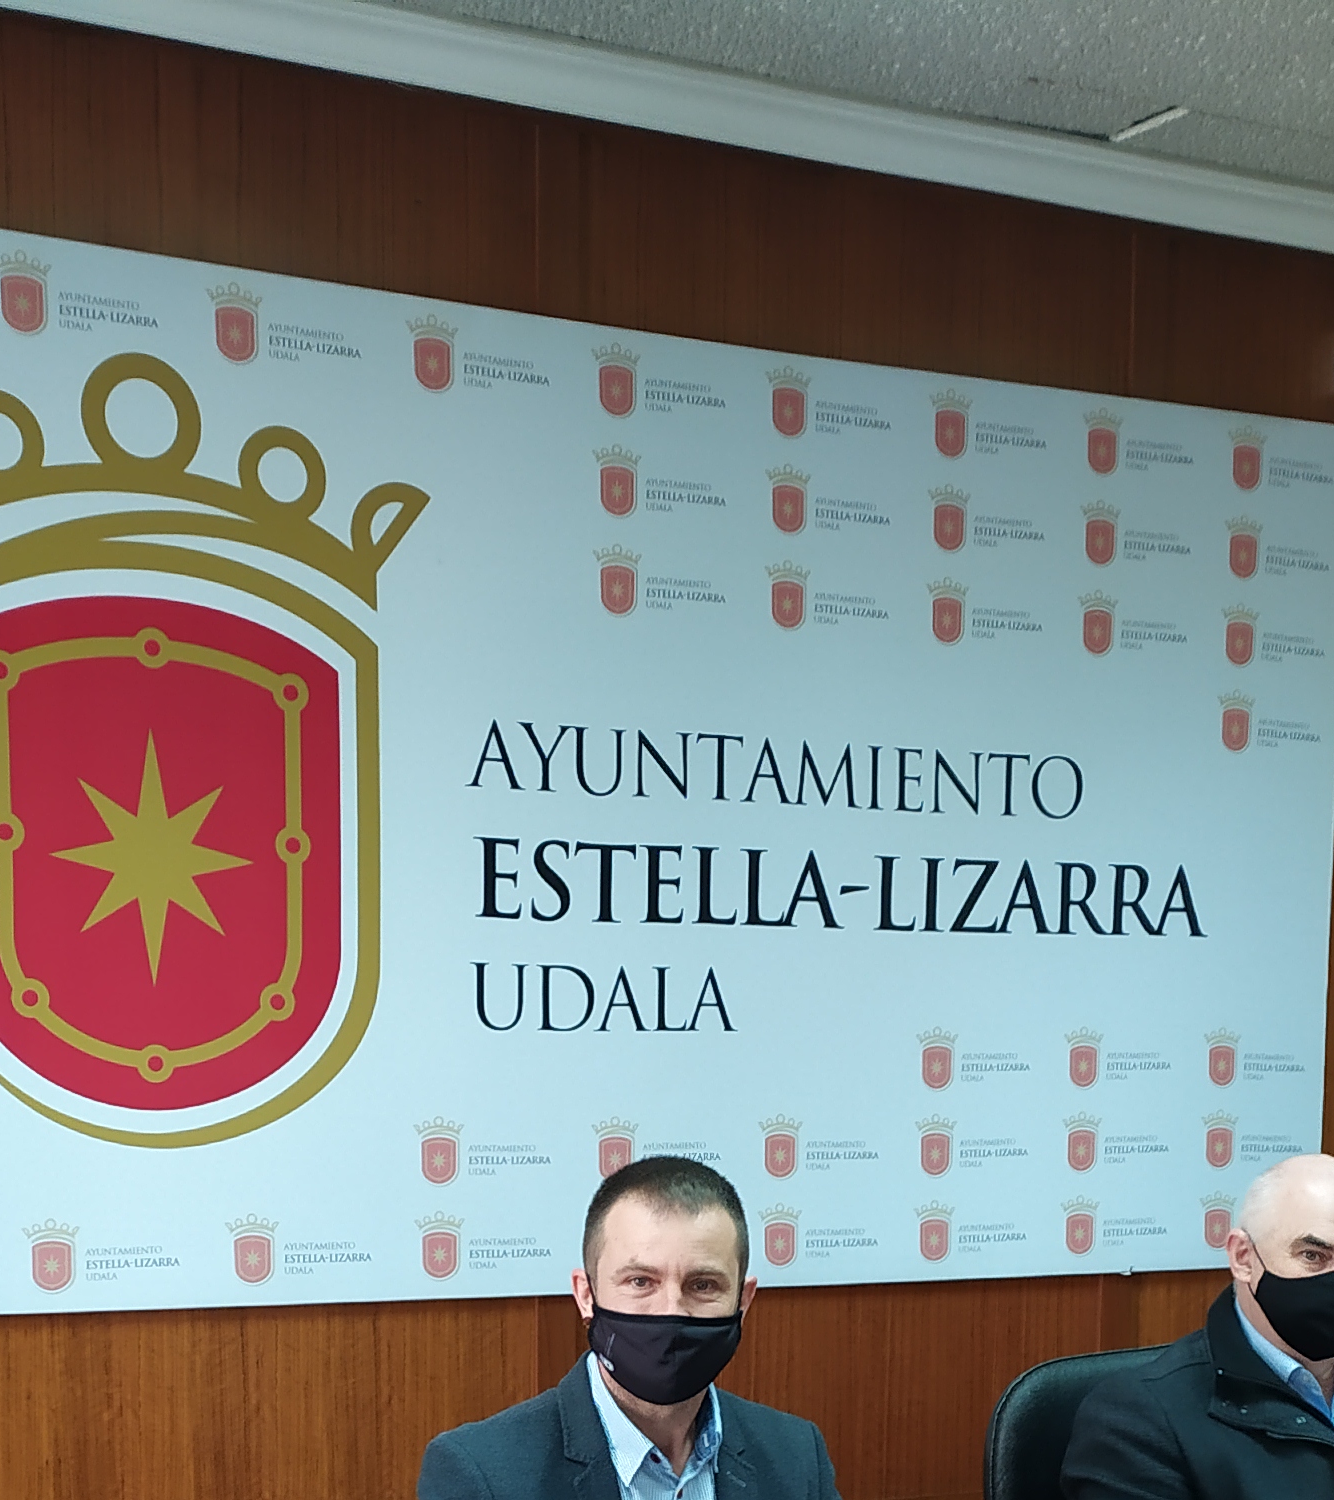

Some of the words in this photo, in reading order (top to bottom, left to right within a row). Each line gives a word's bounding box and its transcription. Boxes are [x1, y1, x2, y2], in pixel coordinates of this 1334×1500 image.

[57, 291, 140, 311] AYUNTAMIENTO
[58, 303, 159, 329] ESTELLA-LIZARRA
[58, 318, 93, 332] UDALA
[267, 322, 345, 343] AYUNTAMIENTO
[268, 334, 362, 359] ESTELLA-LIZARRA
[268, 347, 300, 362] UDALA
[462, 351, 535, 372] AYUNTAMIENTO
[463, 363, 550, 387] ESTELLA-LIZARRA
[463, 375, 493, 390] UDALA
[644, 388, 726, 409] ESTELLA-LIZARRA
[815, 411, 891, 431] ESTELLA-LIZARRA
[975, 431, 1047, 449] ESTELLA-LIZARRA
[645, 488, 727, 507] ESTELLA-LIZARRA
[815, 507, 891, 526] ESTELLA-LIZARRA
[973, 525, 1045, 541] ESTELLA-LIZARRA
[645, 587, 726, 604] ESTELLA-LIZARRA
[814, 602, 889, 620] ESTELLA-LIZARRA
[971, 617, 1043, 632] ESTELLA-LIZARRA
[467, 719, 1083, 820] AYUNTAMIENTO
[474, 836, 1207, 938] ESTELLA-LIZARRA
[471, 962, 736, 1032] UDALA
[961, 1062, 1031, 1073] ESTELLA-LIZARRA
[467, 1144, 537, 1154] AYUNTAMIENTO
[642, 1141, 707, 1151] AYUNTAMIENTO
[805, 1140, 867, 1149] AYUNTAMIENTO
[806, 1150, 879, 1161] ESTELLA-LIZARRA
[959, 1147, 1029, 1159] ESTELLA-LIZARRA
[468, 1155, 552, 1166] ESTELLA-LIZARRA
[805, 1162, 831, 1171] UDALA
[467, 1167, 497, 1176] UDALA
[804, 1228, 866, 1237] AYUNTAMIENTO
[958, 1232, 1027, 1244] ESTELLA-LIZARRA
[283, 1241, 356, 1252] AYUNTAMIENTO
[468, 1237, 537, 1247] AYUNTAMIENTO
[805, 1237, 879, 1249] ESTELLA-LIZARRA
[84, 1245, 163, 1257] AYUNTAMIENTO
[468, 1248, 552, 1259] ESTELLA-LIZARRA
[804, 1250, 830, 1258] UDALA
[85, 1256, 181, 1271] ESTELLA-LIZARRA
[284, 1252, 372, 1265] ESTELLA-LIZARRA
[468, 1260, 498, 1270] UDALA
[85, 1271, 118, 1282] UDALA
[283, 1265, 314, 1275] UDALA
